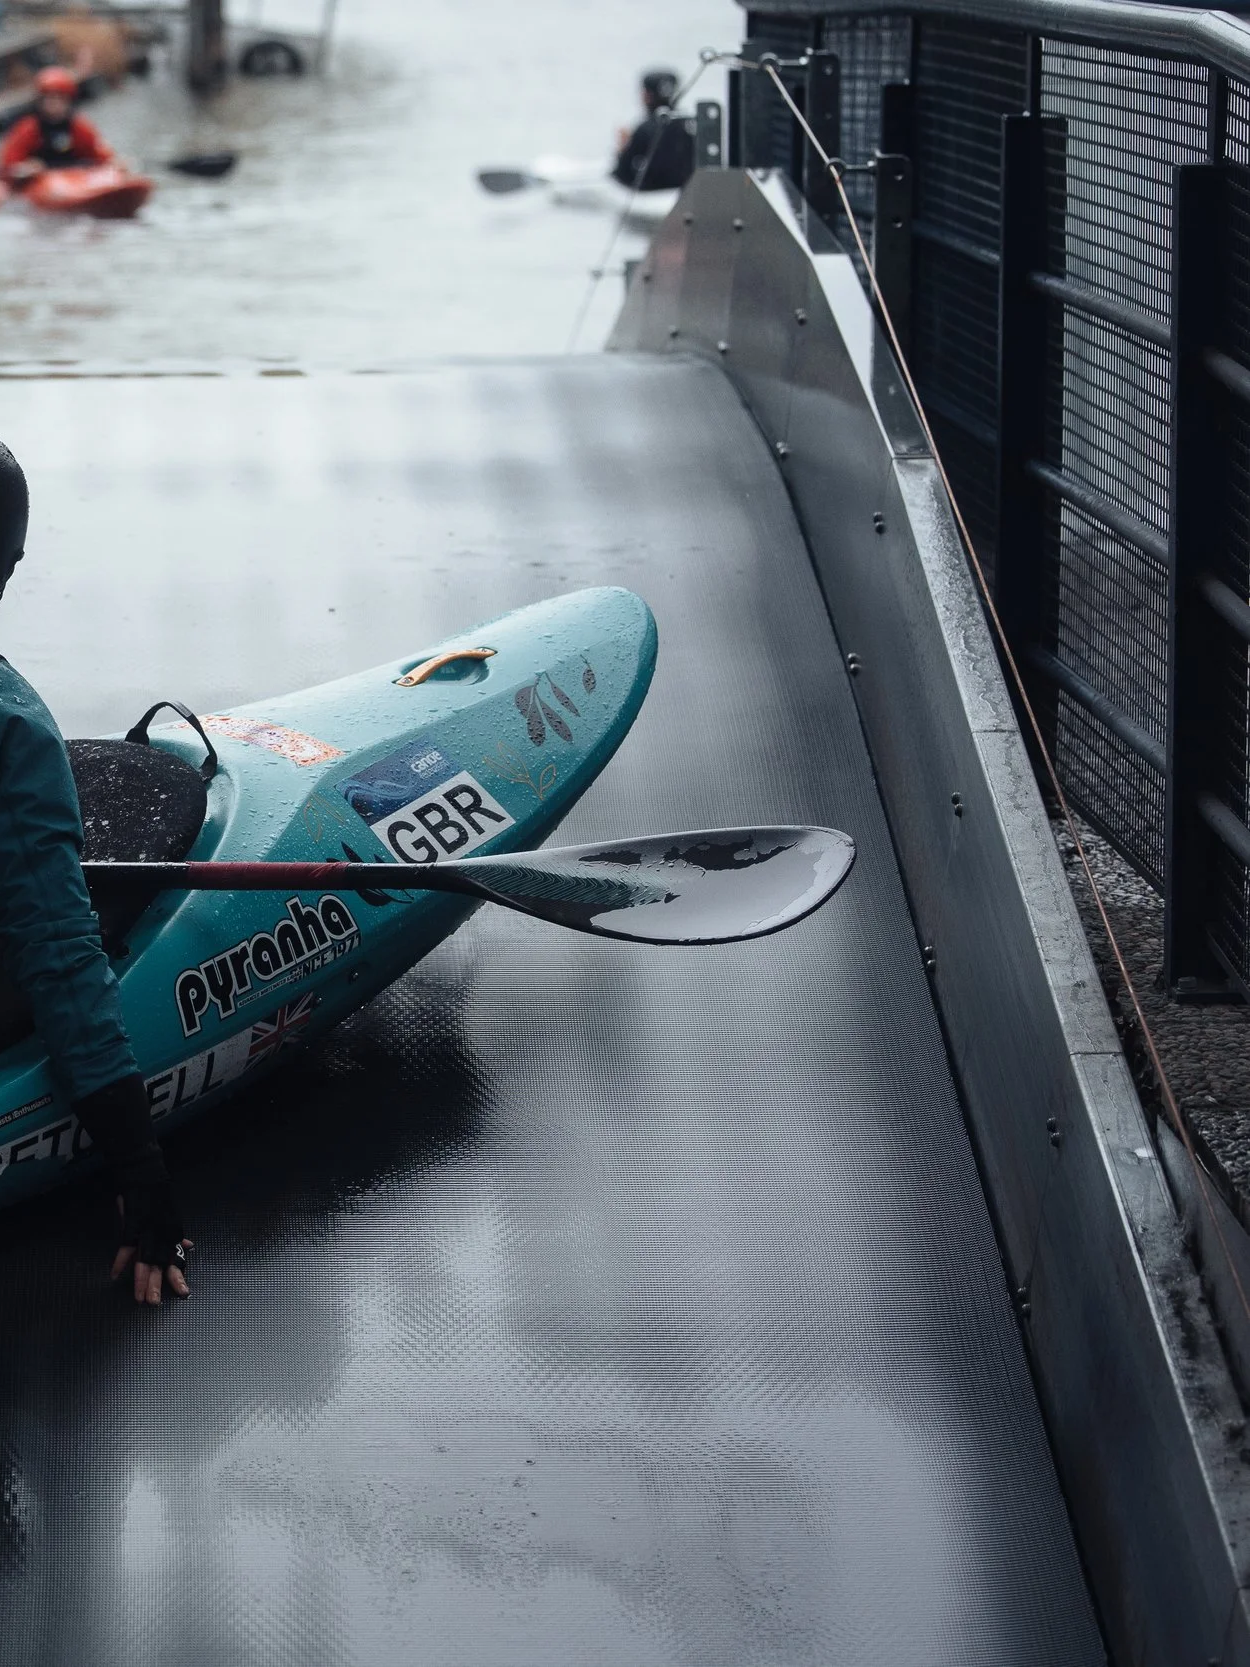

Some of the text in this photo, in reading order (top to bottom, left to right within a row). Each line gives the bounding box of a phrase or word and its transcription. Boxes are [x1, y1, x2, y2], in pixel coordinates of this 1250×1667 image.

[411, 751, 442, 772] canoe
[386, 783, 505, 864] GBR
[175, 894, 359, 1037] pyranha
